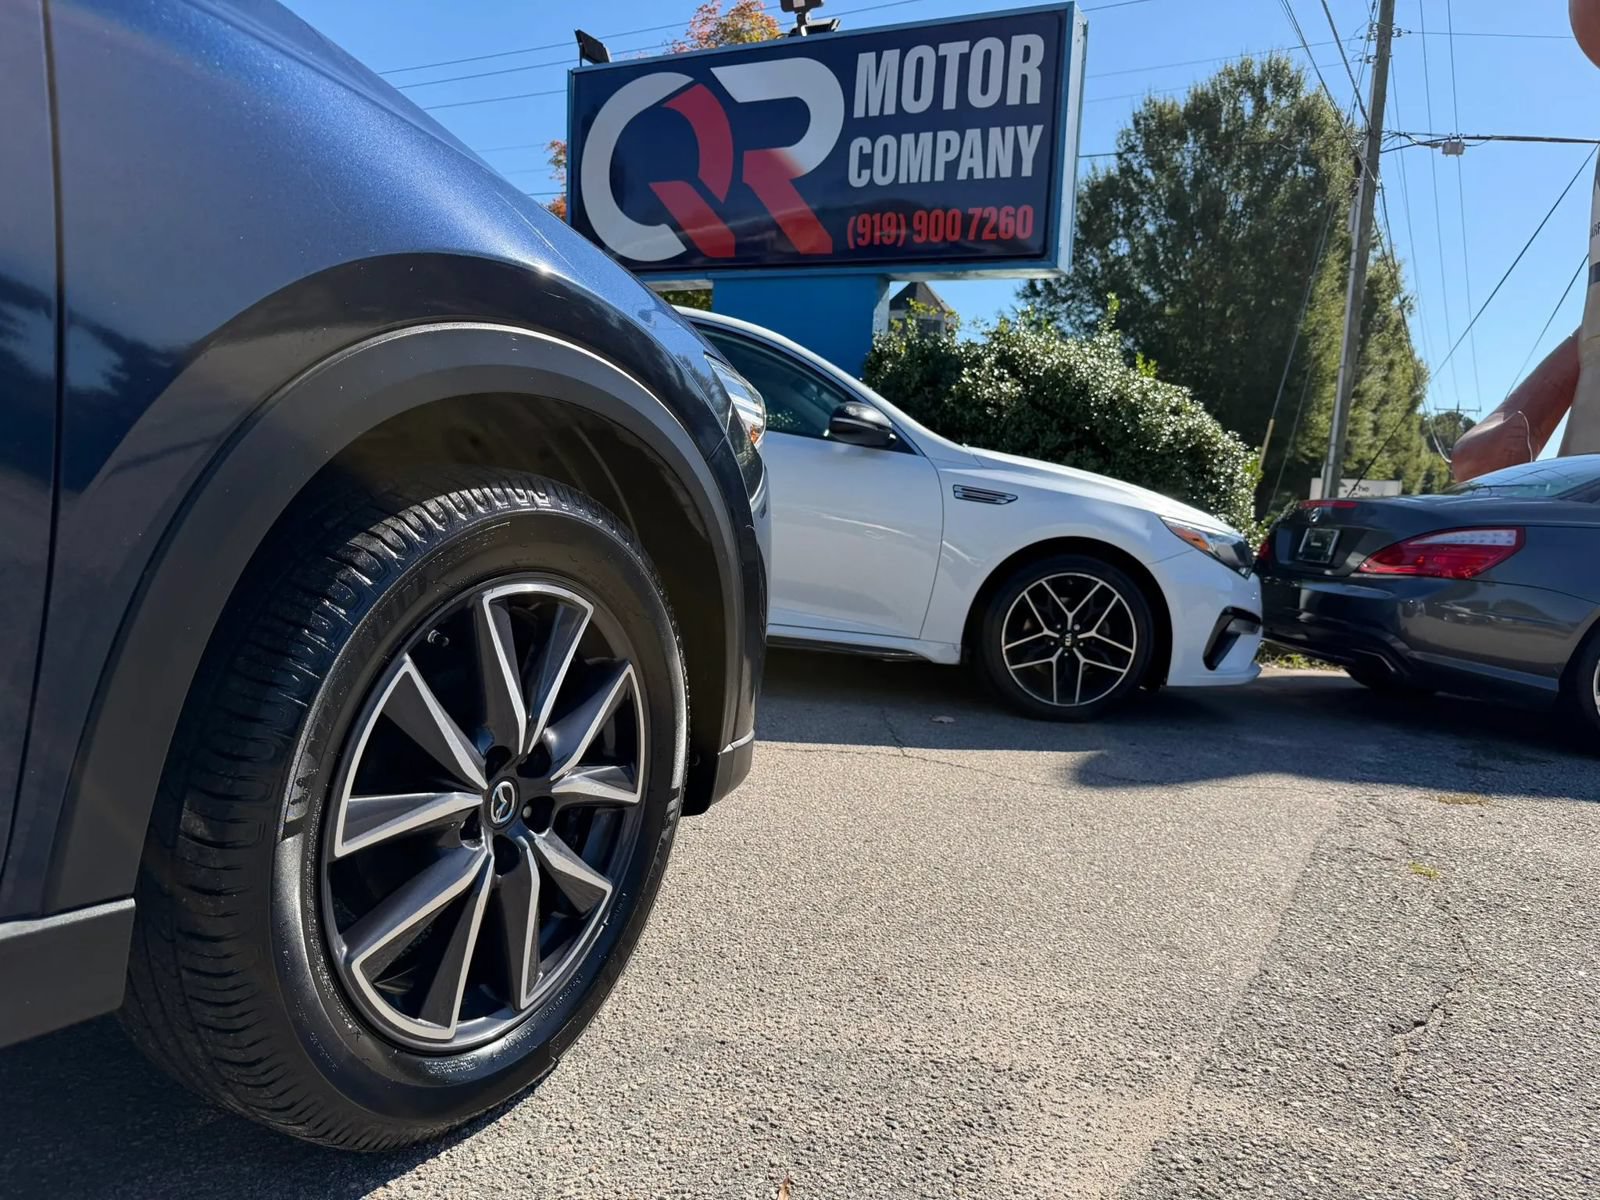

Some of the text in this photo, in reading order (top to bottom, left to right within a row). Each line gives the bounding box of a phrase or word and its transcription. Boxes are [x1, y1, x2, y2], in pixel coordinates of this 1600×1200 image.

[853, 34, 1045, 118] MOTOR
[848, 124, 1045, 188] COMPANY
[847, 204, 1034, 249] (919) 900 7260
